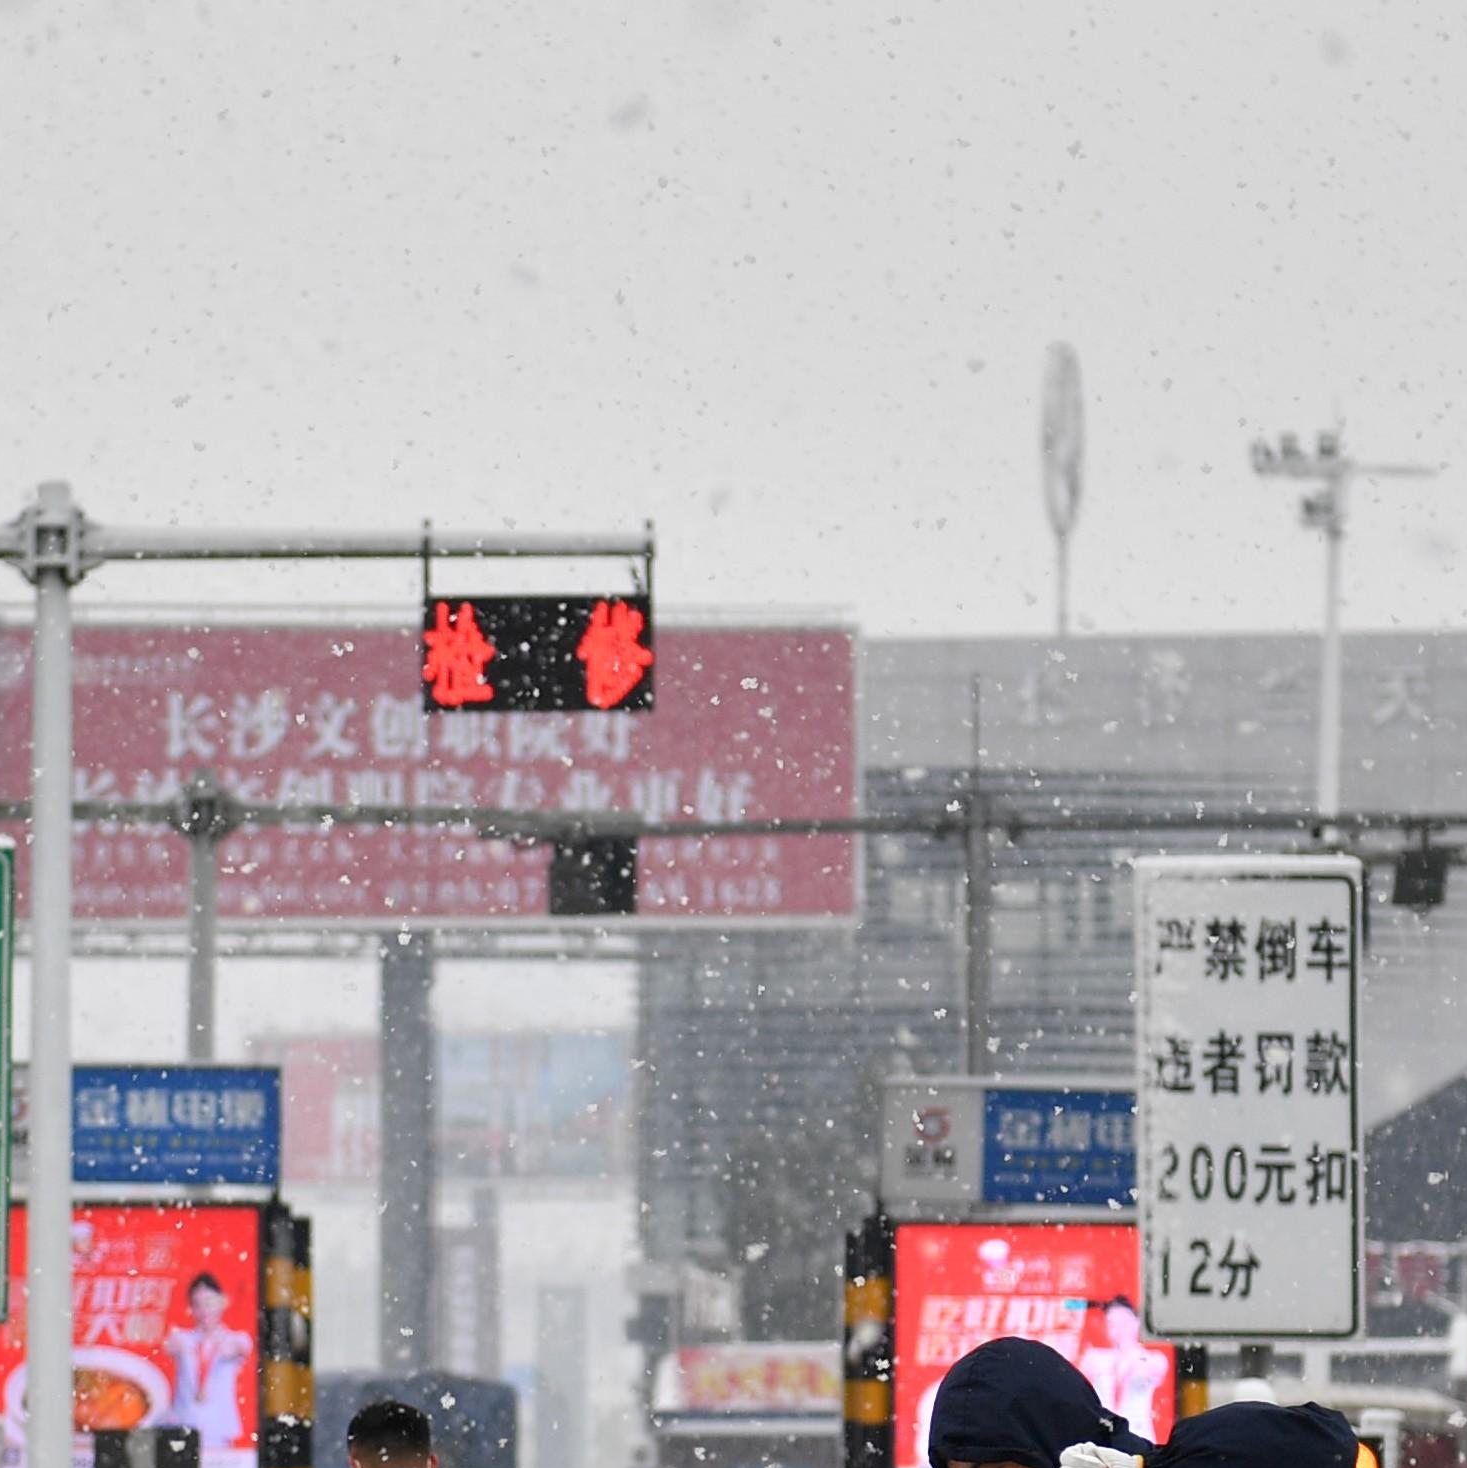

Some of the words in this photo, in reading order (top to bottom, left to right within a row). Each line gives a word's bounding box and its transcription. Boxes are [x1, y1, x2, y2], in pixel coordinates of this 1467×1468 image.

[1156, 917, 1349, 981] 严禁倒车
[1156, 1030, 1349, 1094] 违者罚款
[1158, 1143, 1347, 1202] 200元扣
[1160, 1236, 1260, 1299] 12分
